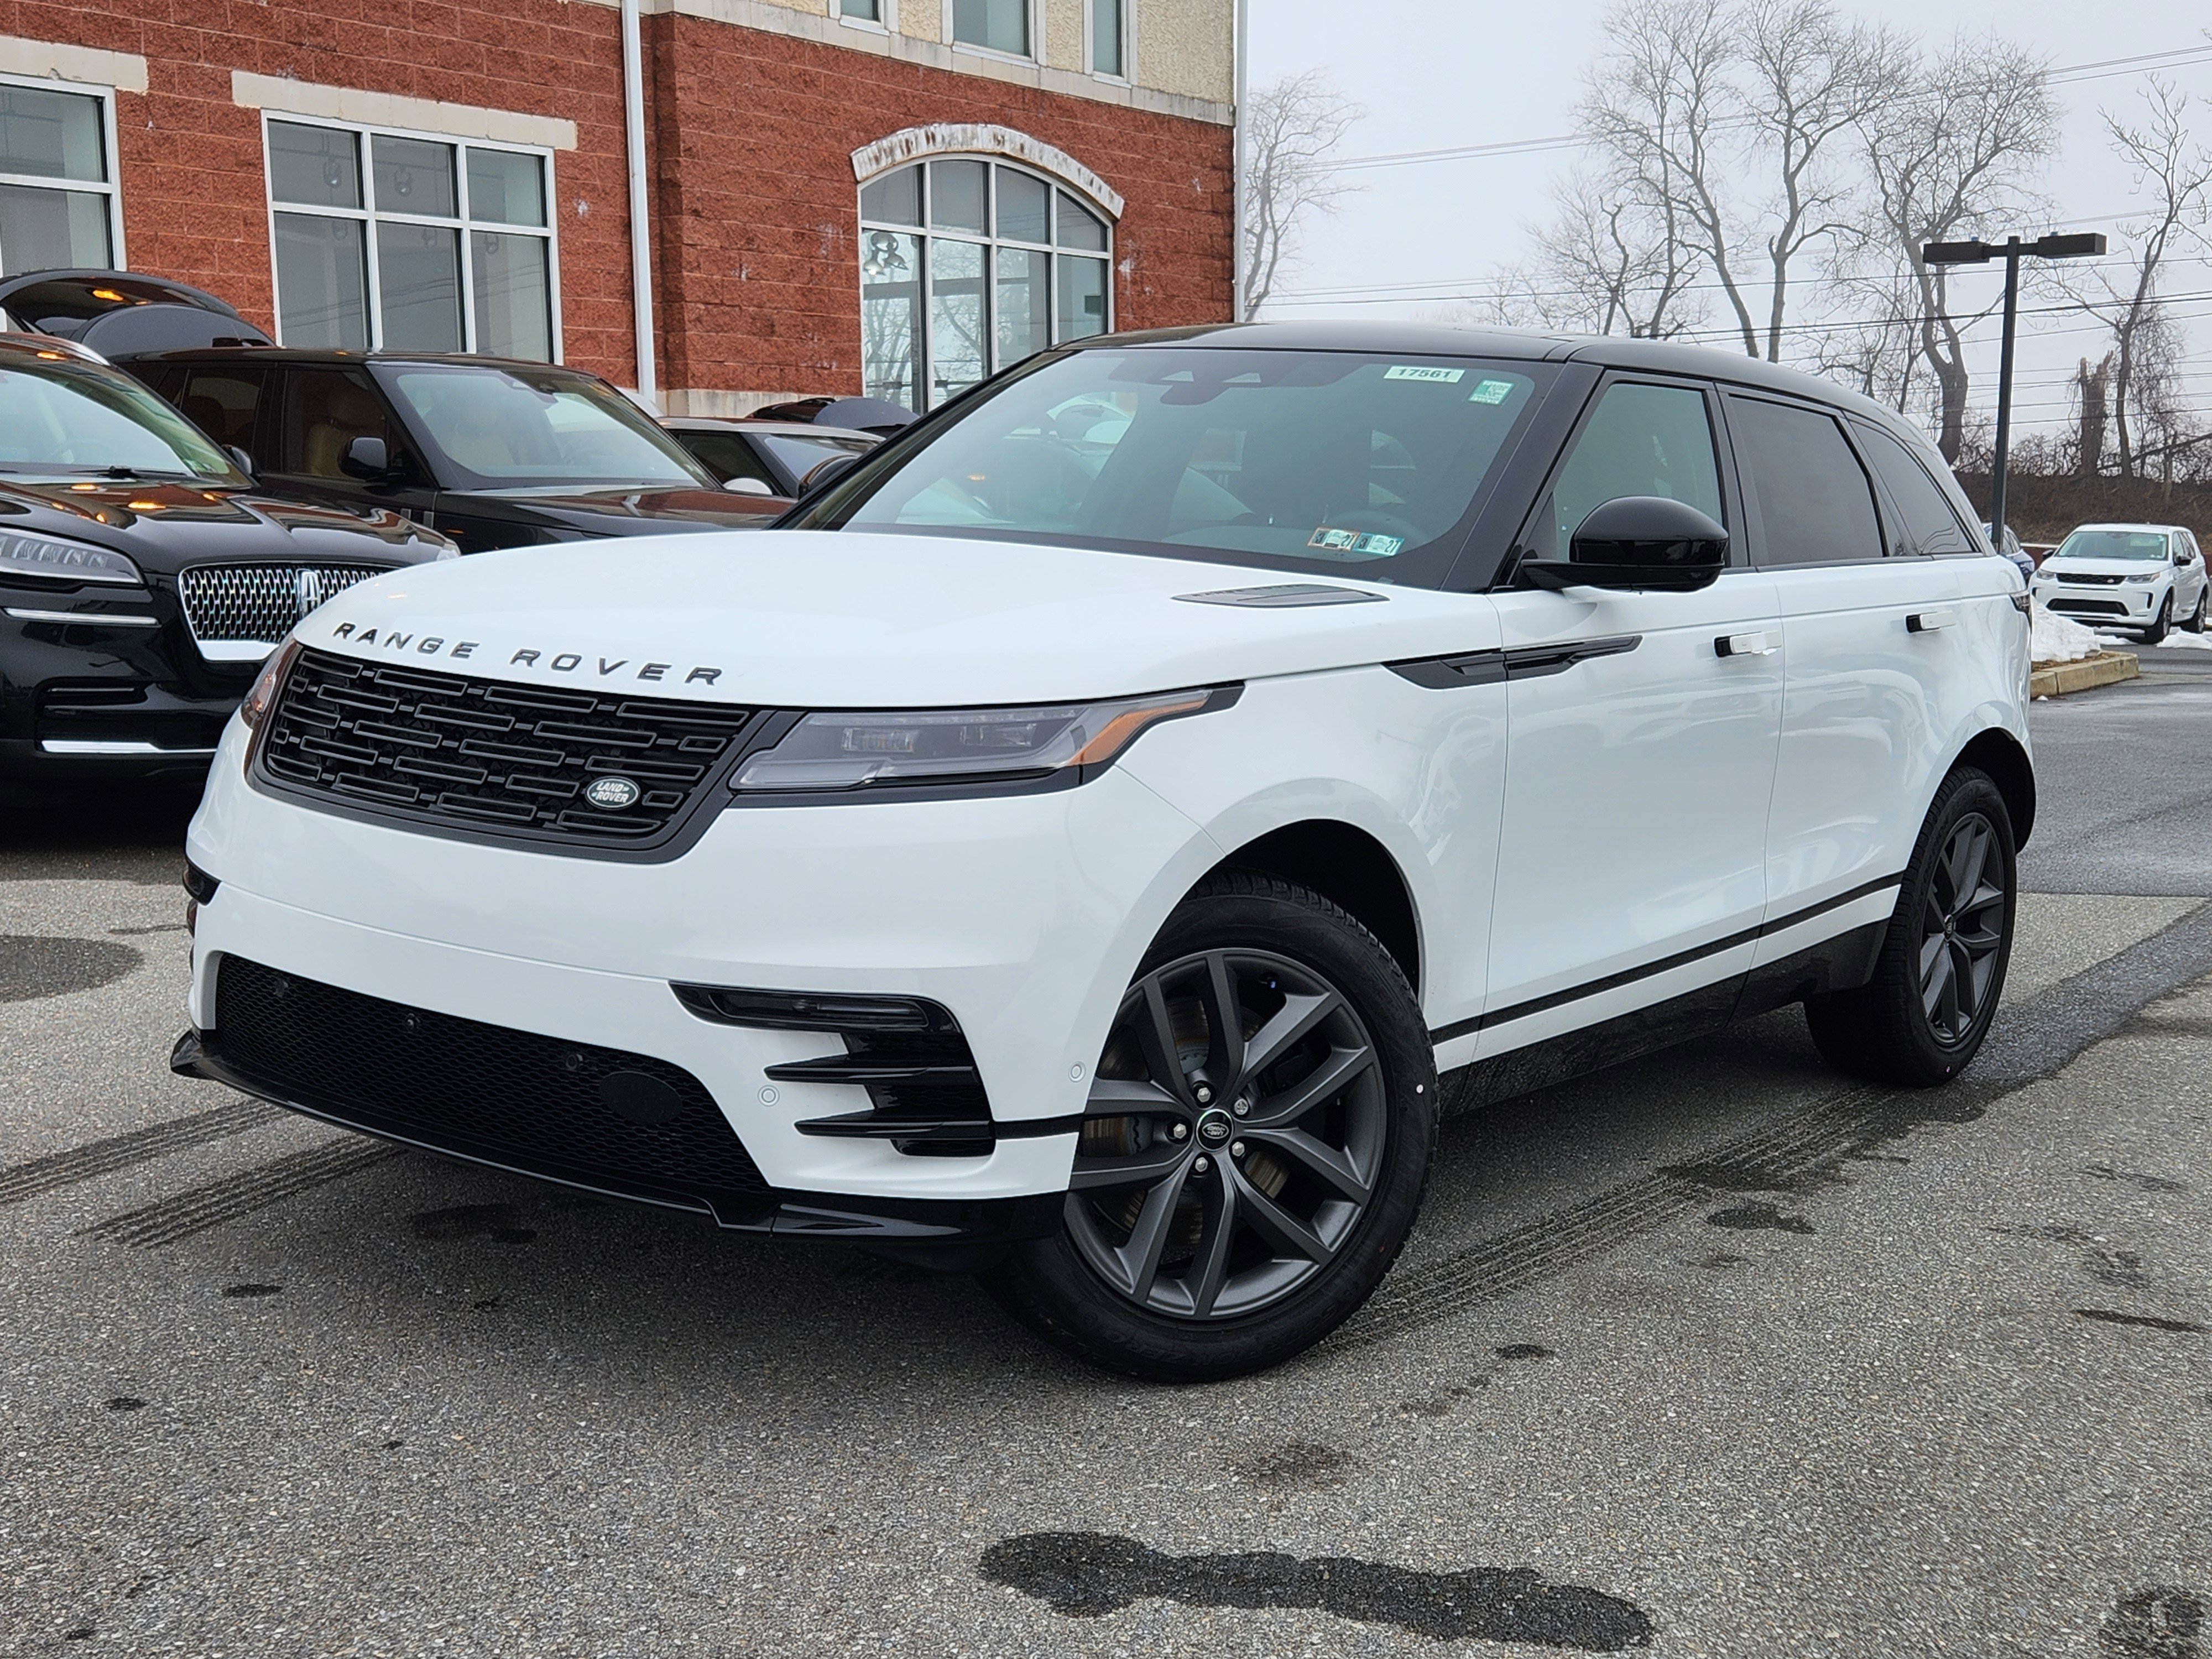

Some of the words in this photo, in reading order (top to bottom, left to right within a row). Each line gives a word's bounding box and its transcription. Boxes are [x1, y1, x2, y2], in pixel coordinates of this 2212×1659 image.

[1398, 368, 1452, 378] 17561
[332, 622, 479, 659] RANGE
[510, 649, 722, 686] ROVER
[597, 782, 624, 792] LAND
[596, 791, 629, 803] ROVER
